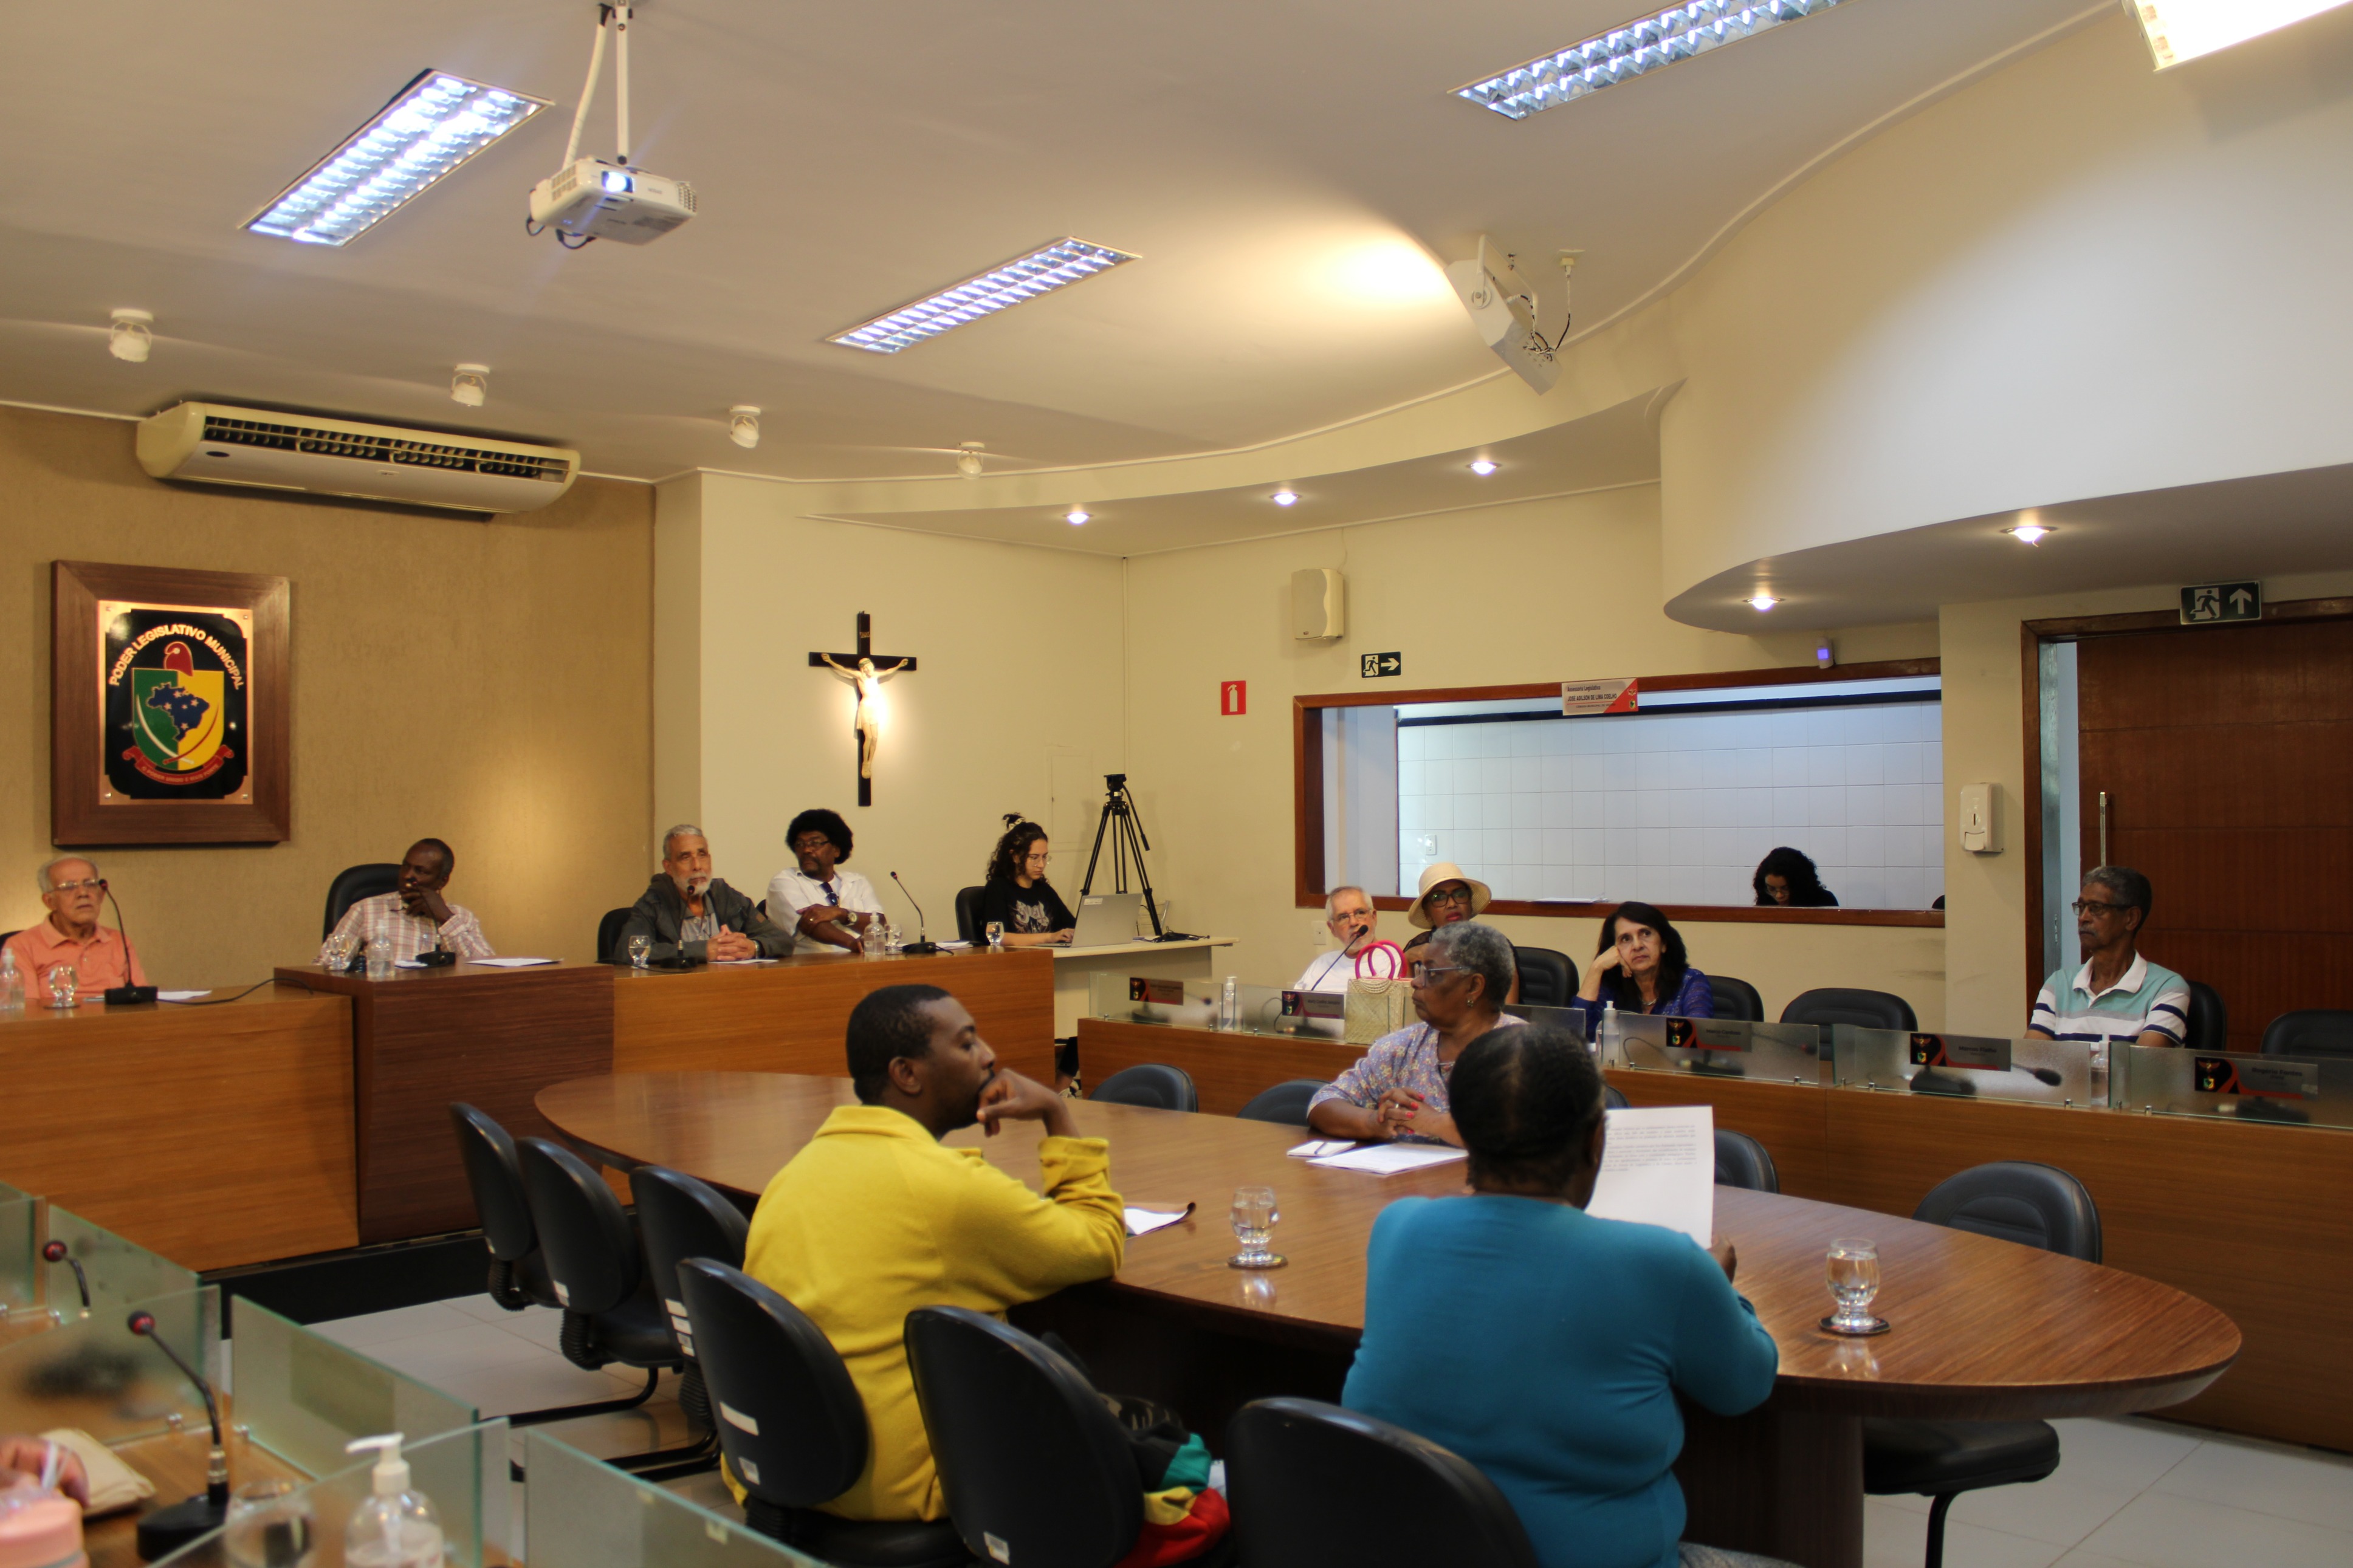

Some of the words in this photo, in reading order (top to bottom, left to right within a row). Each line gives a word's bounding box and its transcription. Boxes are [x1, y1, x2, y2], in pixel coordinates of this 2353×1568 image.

[108, 647, 137, 686] PODER
[131, 624, 206, 651] LEGISLATIVO
[204, 635, 244, 690] MUNICIPAL
